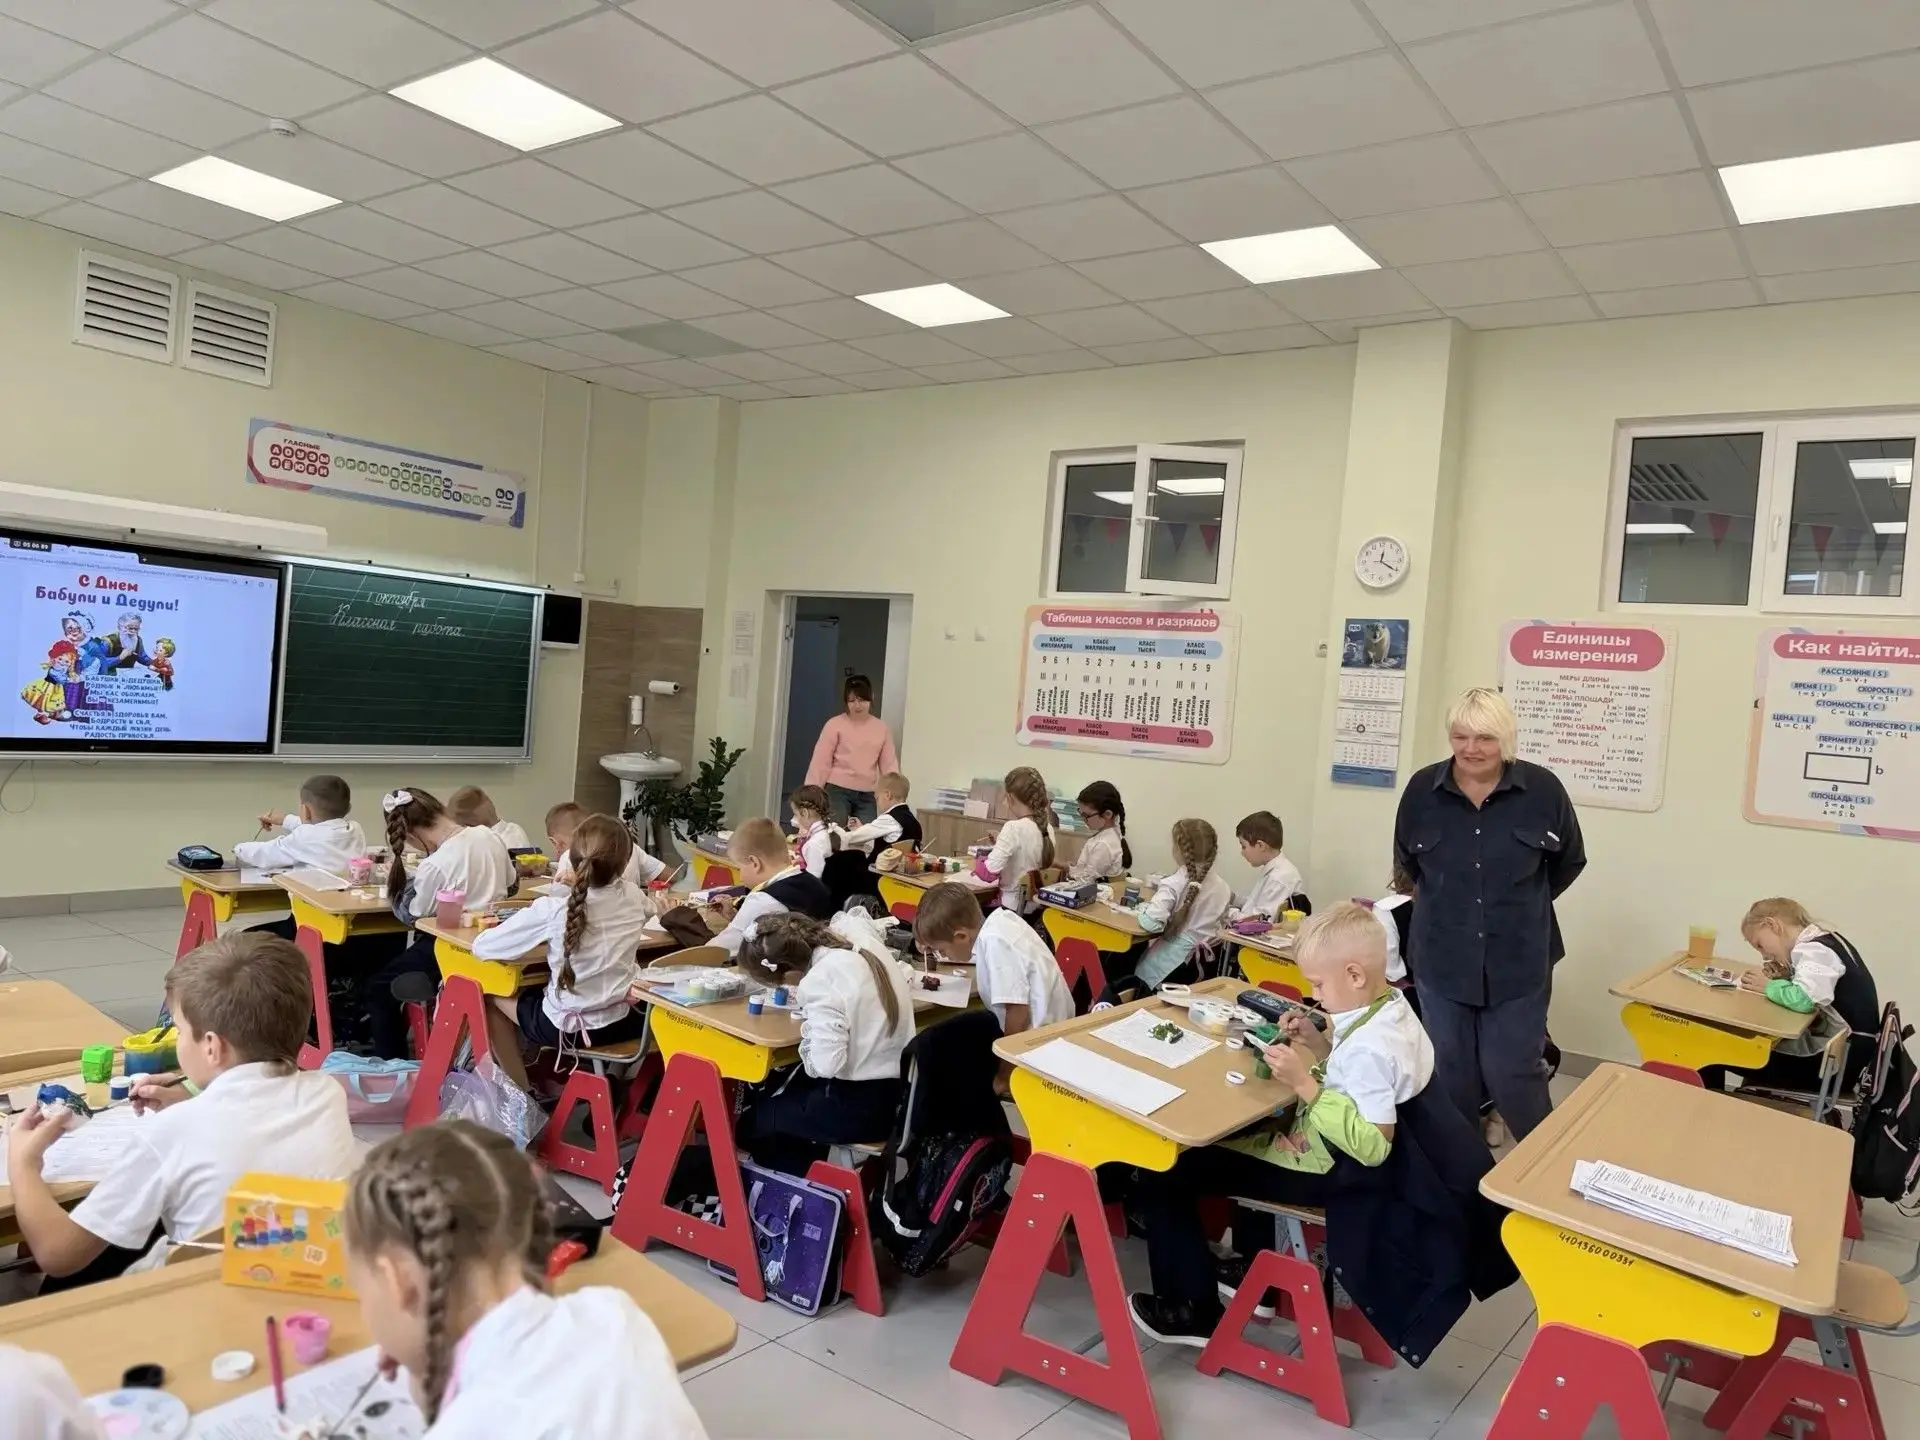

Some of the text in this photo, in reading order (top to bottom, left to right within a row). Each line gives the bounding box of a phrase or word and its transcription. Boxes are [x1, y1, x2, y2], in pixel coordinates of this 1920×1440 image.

[283, 438, 320, 450] ГЛАСНЫЕ
[78, 574, 138, 592] С Днем
[35, 586, 180, 612] Бабули и Дедули!
[330, 603, 396, 631] Классная
[1046, 612, 1217, 630] Таблица классов и разрядов
[1542, 631, 1631, 647] Единицы
[1184, 648, 1207, 656] ЕДИНИЦ
[1788, 640, 1831, 654] Как
[1532, 650, 1638, 664] измерения
[1192, 663, 1197, 672] 5
[1821, 668, 1871, 677] РАССТОЯНИЕ
[1816, 700, 1865, 709] СТОИМОСТЬ
[74, 709, 106, 717] СЧАСТЬЯ
[1848, 721, 1906, 730] КОЛИЧЕСТВО
[1875, 765, 1884, 775] b
[1810, 792, 1852, 802] ПЛОЩАДЬ
